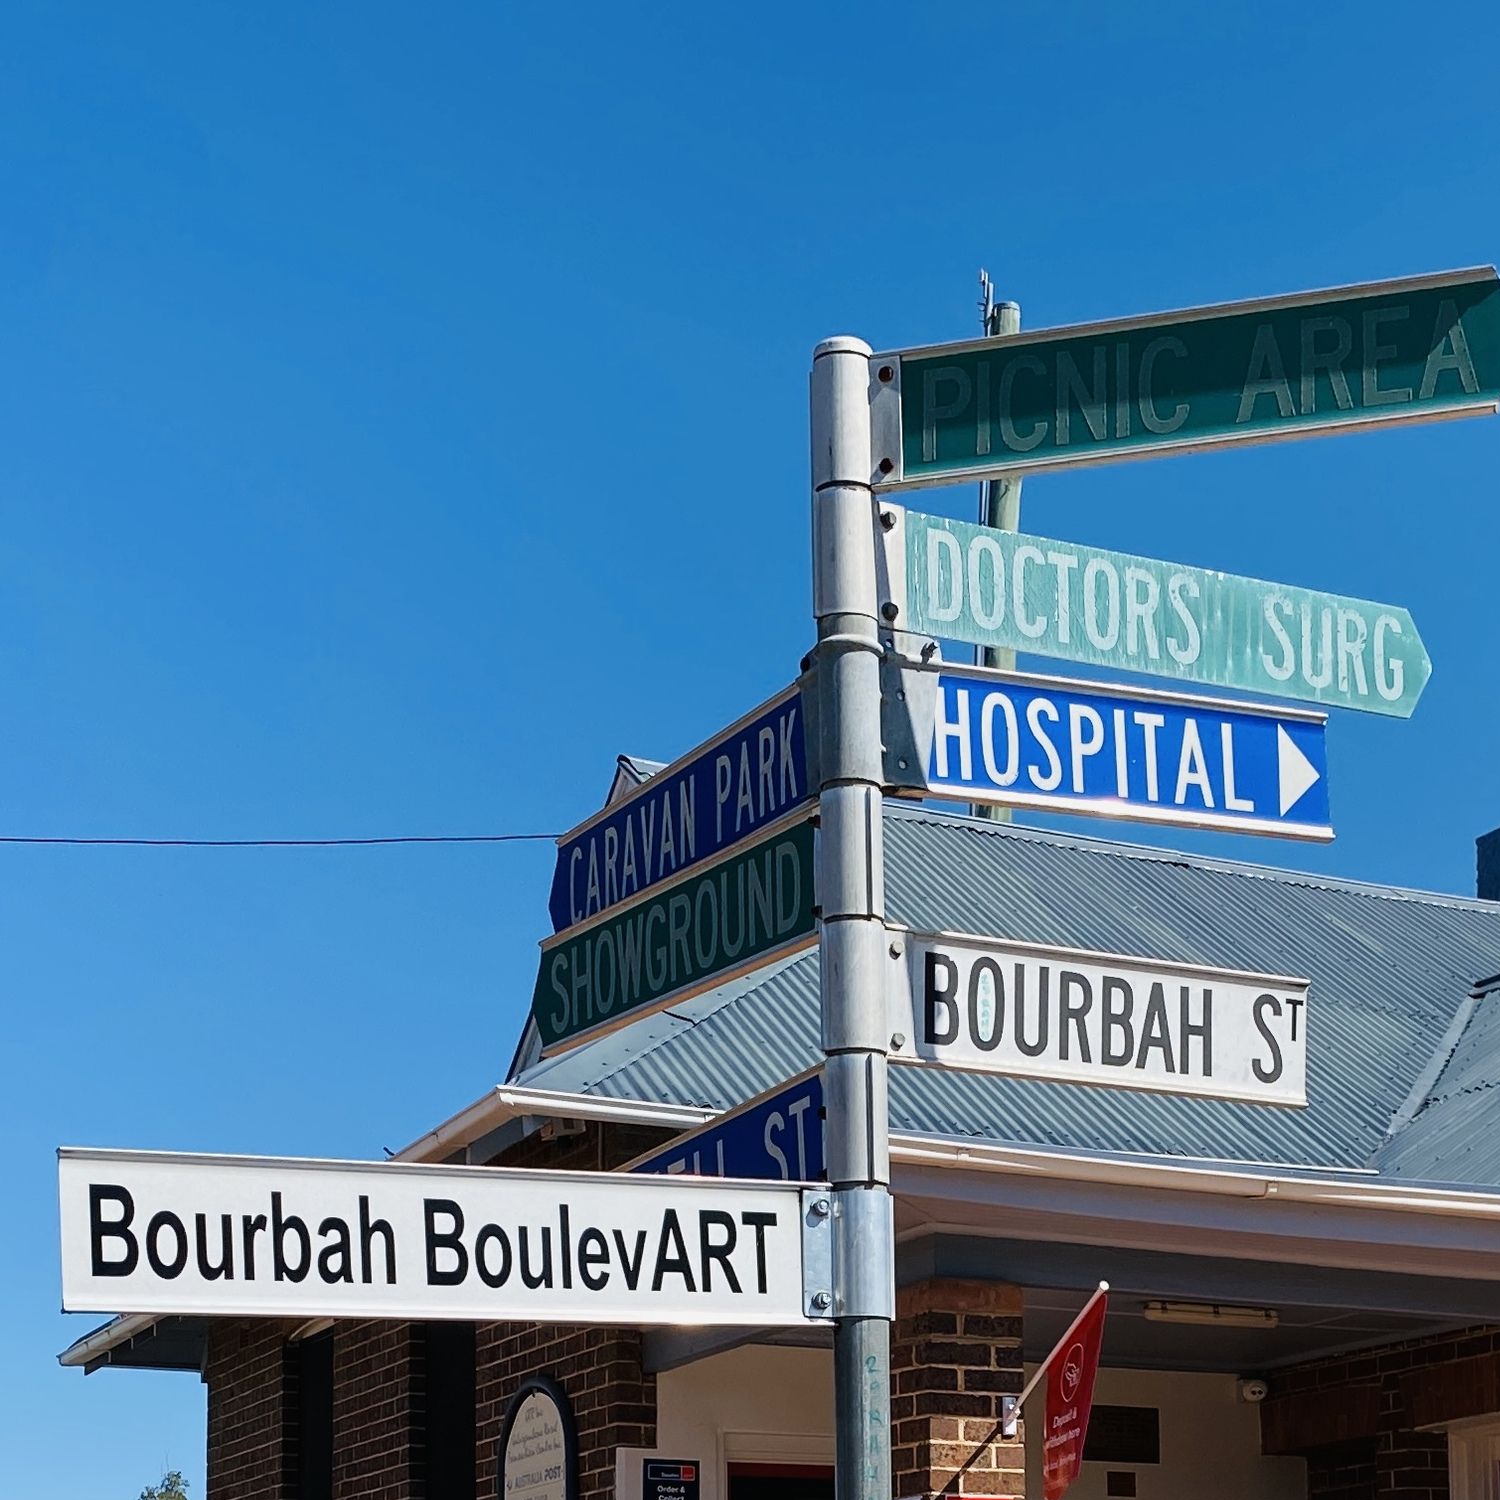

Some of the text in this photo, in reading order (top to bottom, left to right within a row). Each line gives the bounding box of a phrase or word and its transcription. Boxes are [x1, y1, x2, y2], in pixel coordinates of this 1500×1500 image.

[922, 300, 1479, 463] PICNIC AREA
[926, 528, 1404, 700] DOCTORS SURG
[570, 709, 799, 924] CARAVAN PARK
[934, 686, 1255, 812] HOSPITAL
[551, 841, 801, 1034] SHOWGROUND
[925, 951, 1212, 1077] BOURBAH
[1252, 994, 1303, 1084] ST
[89, 1184, 778, 1295] Bourbah BoulevART
[544, 1465, 561, 1481] POST
